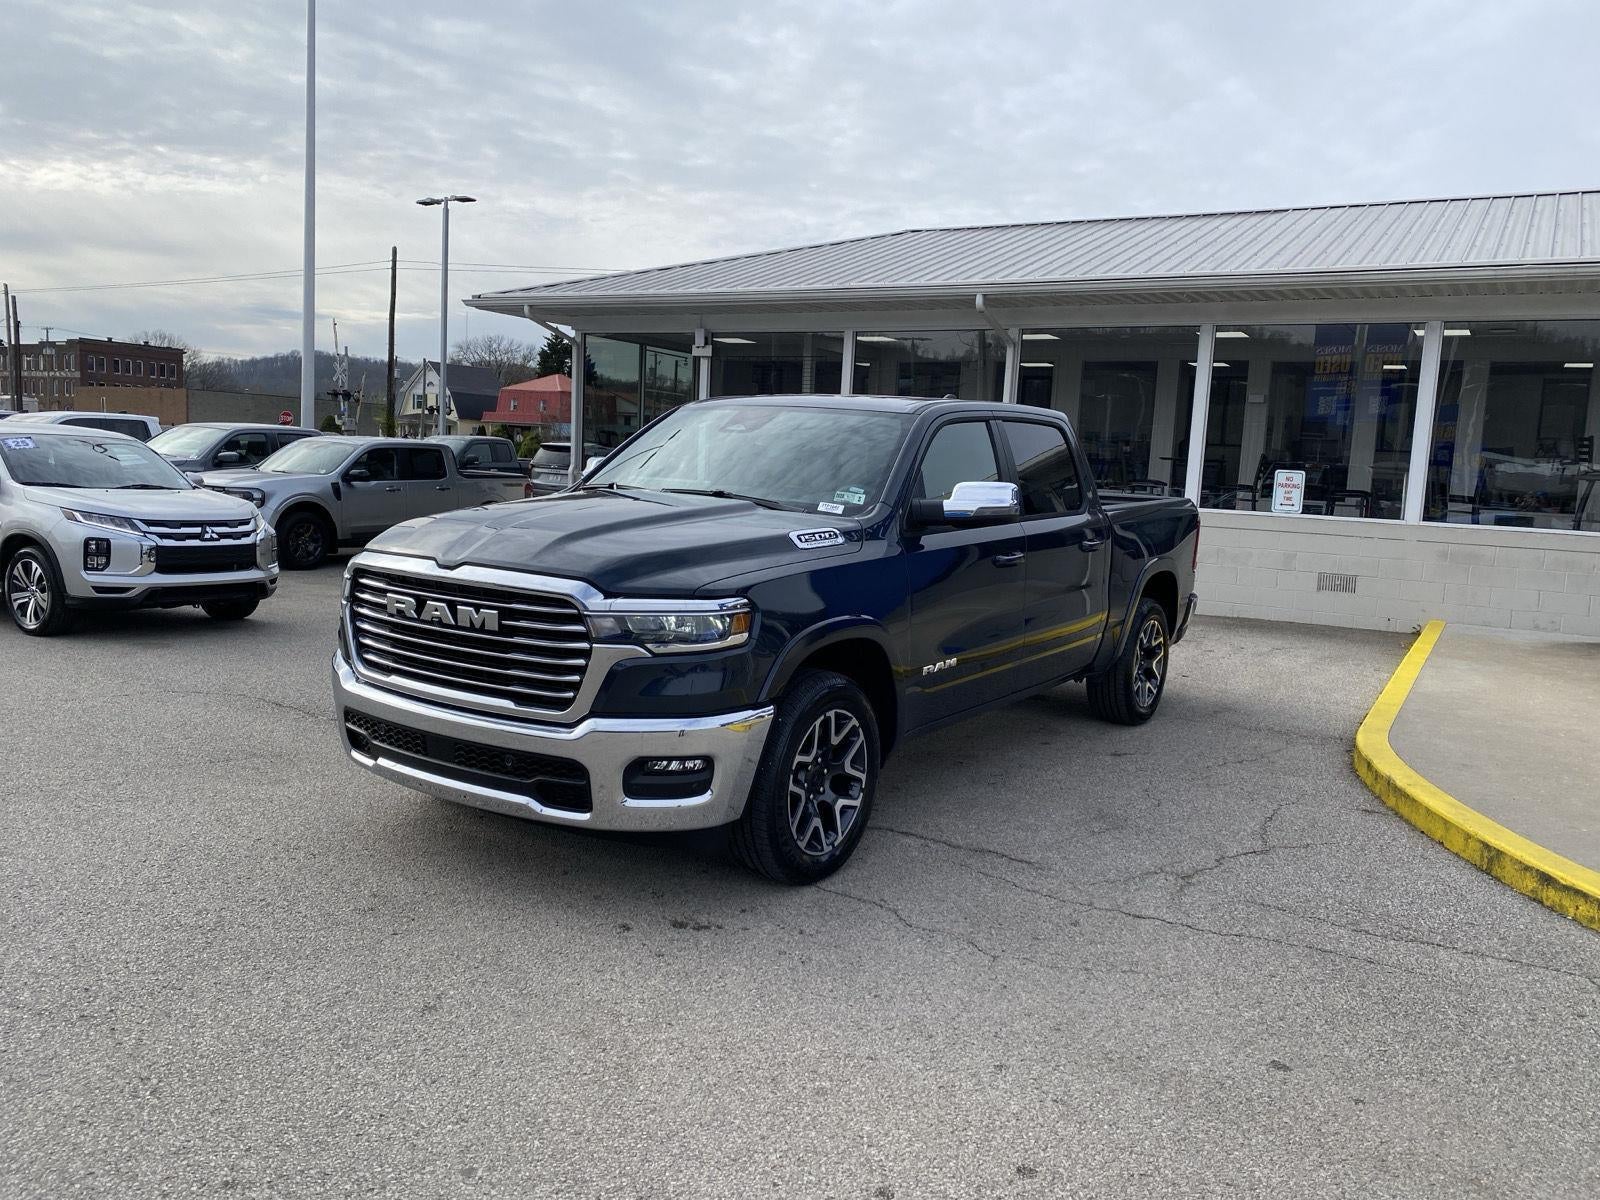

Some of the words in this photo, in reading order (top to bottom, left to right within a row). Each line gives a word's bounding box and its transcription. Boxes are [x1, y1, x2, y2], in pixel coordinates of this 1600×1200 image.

[1277, 482, 1301, 490] PARKING
[798, 532, 837, 542] 1500
[386, 593, 499, 632] RAM
[922, 657, 957, 676] RAM
